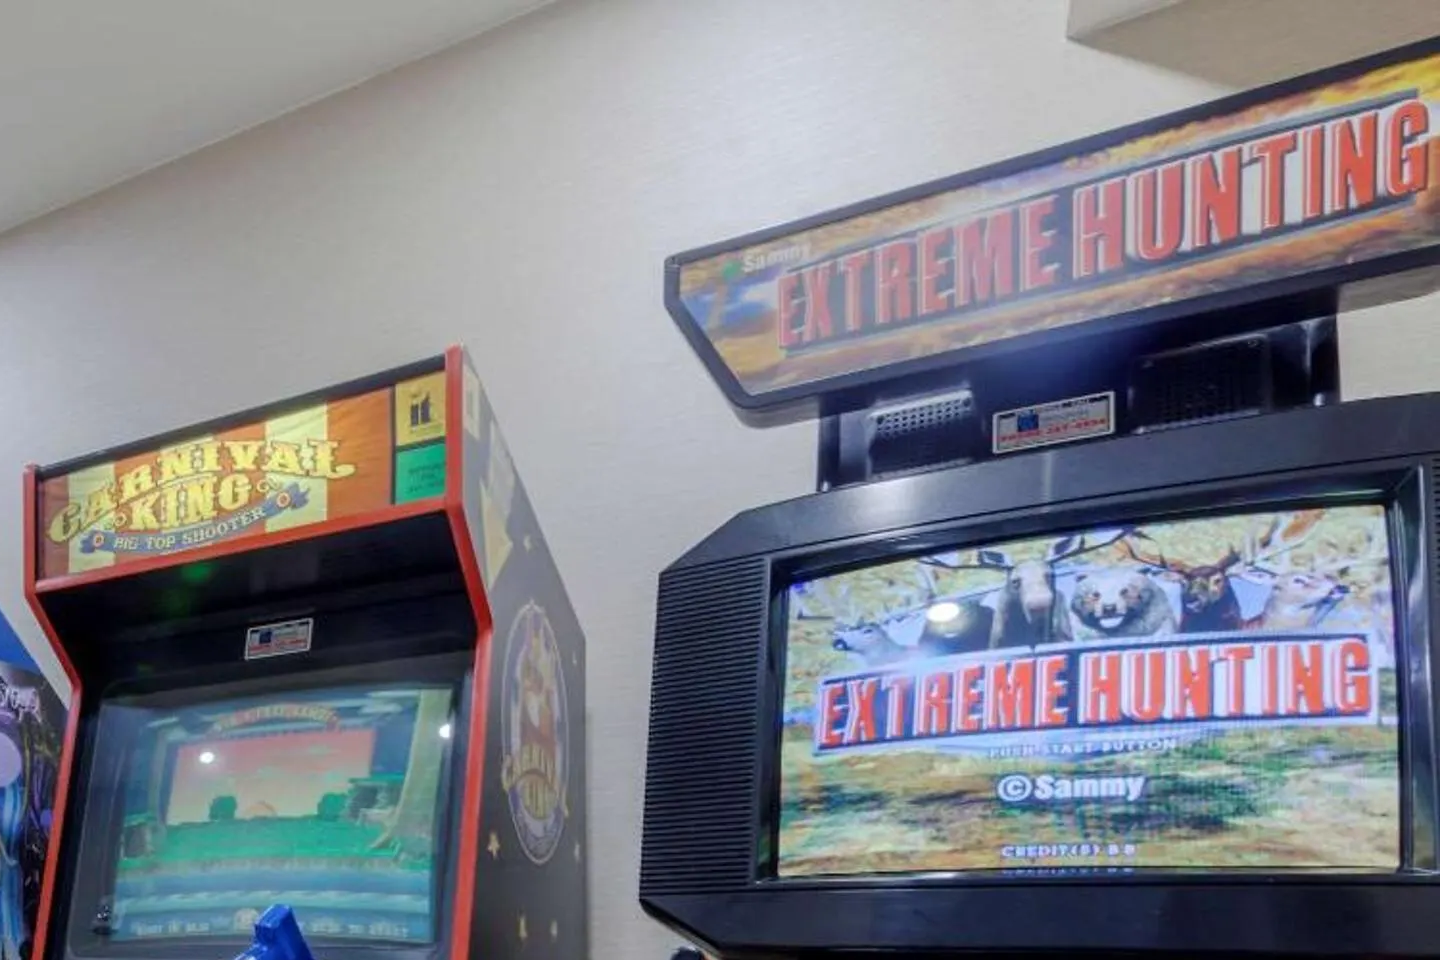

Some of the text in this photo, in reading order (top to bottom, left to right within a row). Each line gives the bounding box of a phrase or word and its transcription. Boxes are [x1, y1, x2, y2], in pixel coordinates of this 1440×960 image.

[778, 99, 1430, 348] EXTREME HUNTING
[46, 440, 356, 543] CARNIVAL
[113, 506, 268, 551] BIG TOP SHOOTER
[129, 473, 253, 532] KING
[817, 637, 1373, 749] EXTREME HUNTING
[1102, 738, 1177, 753] BUTTON
